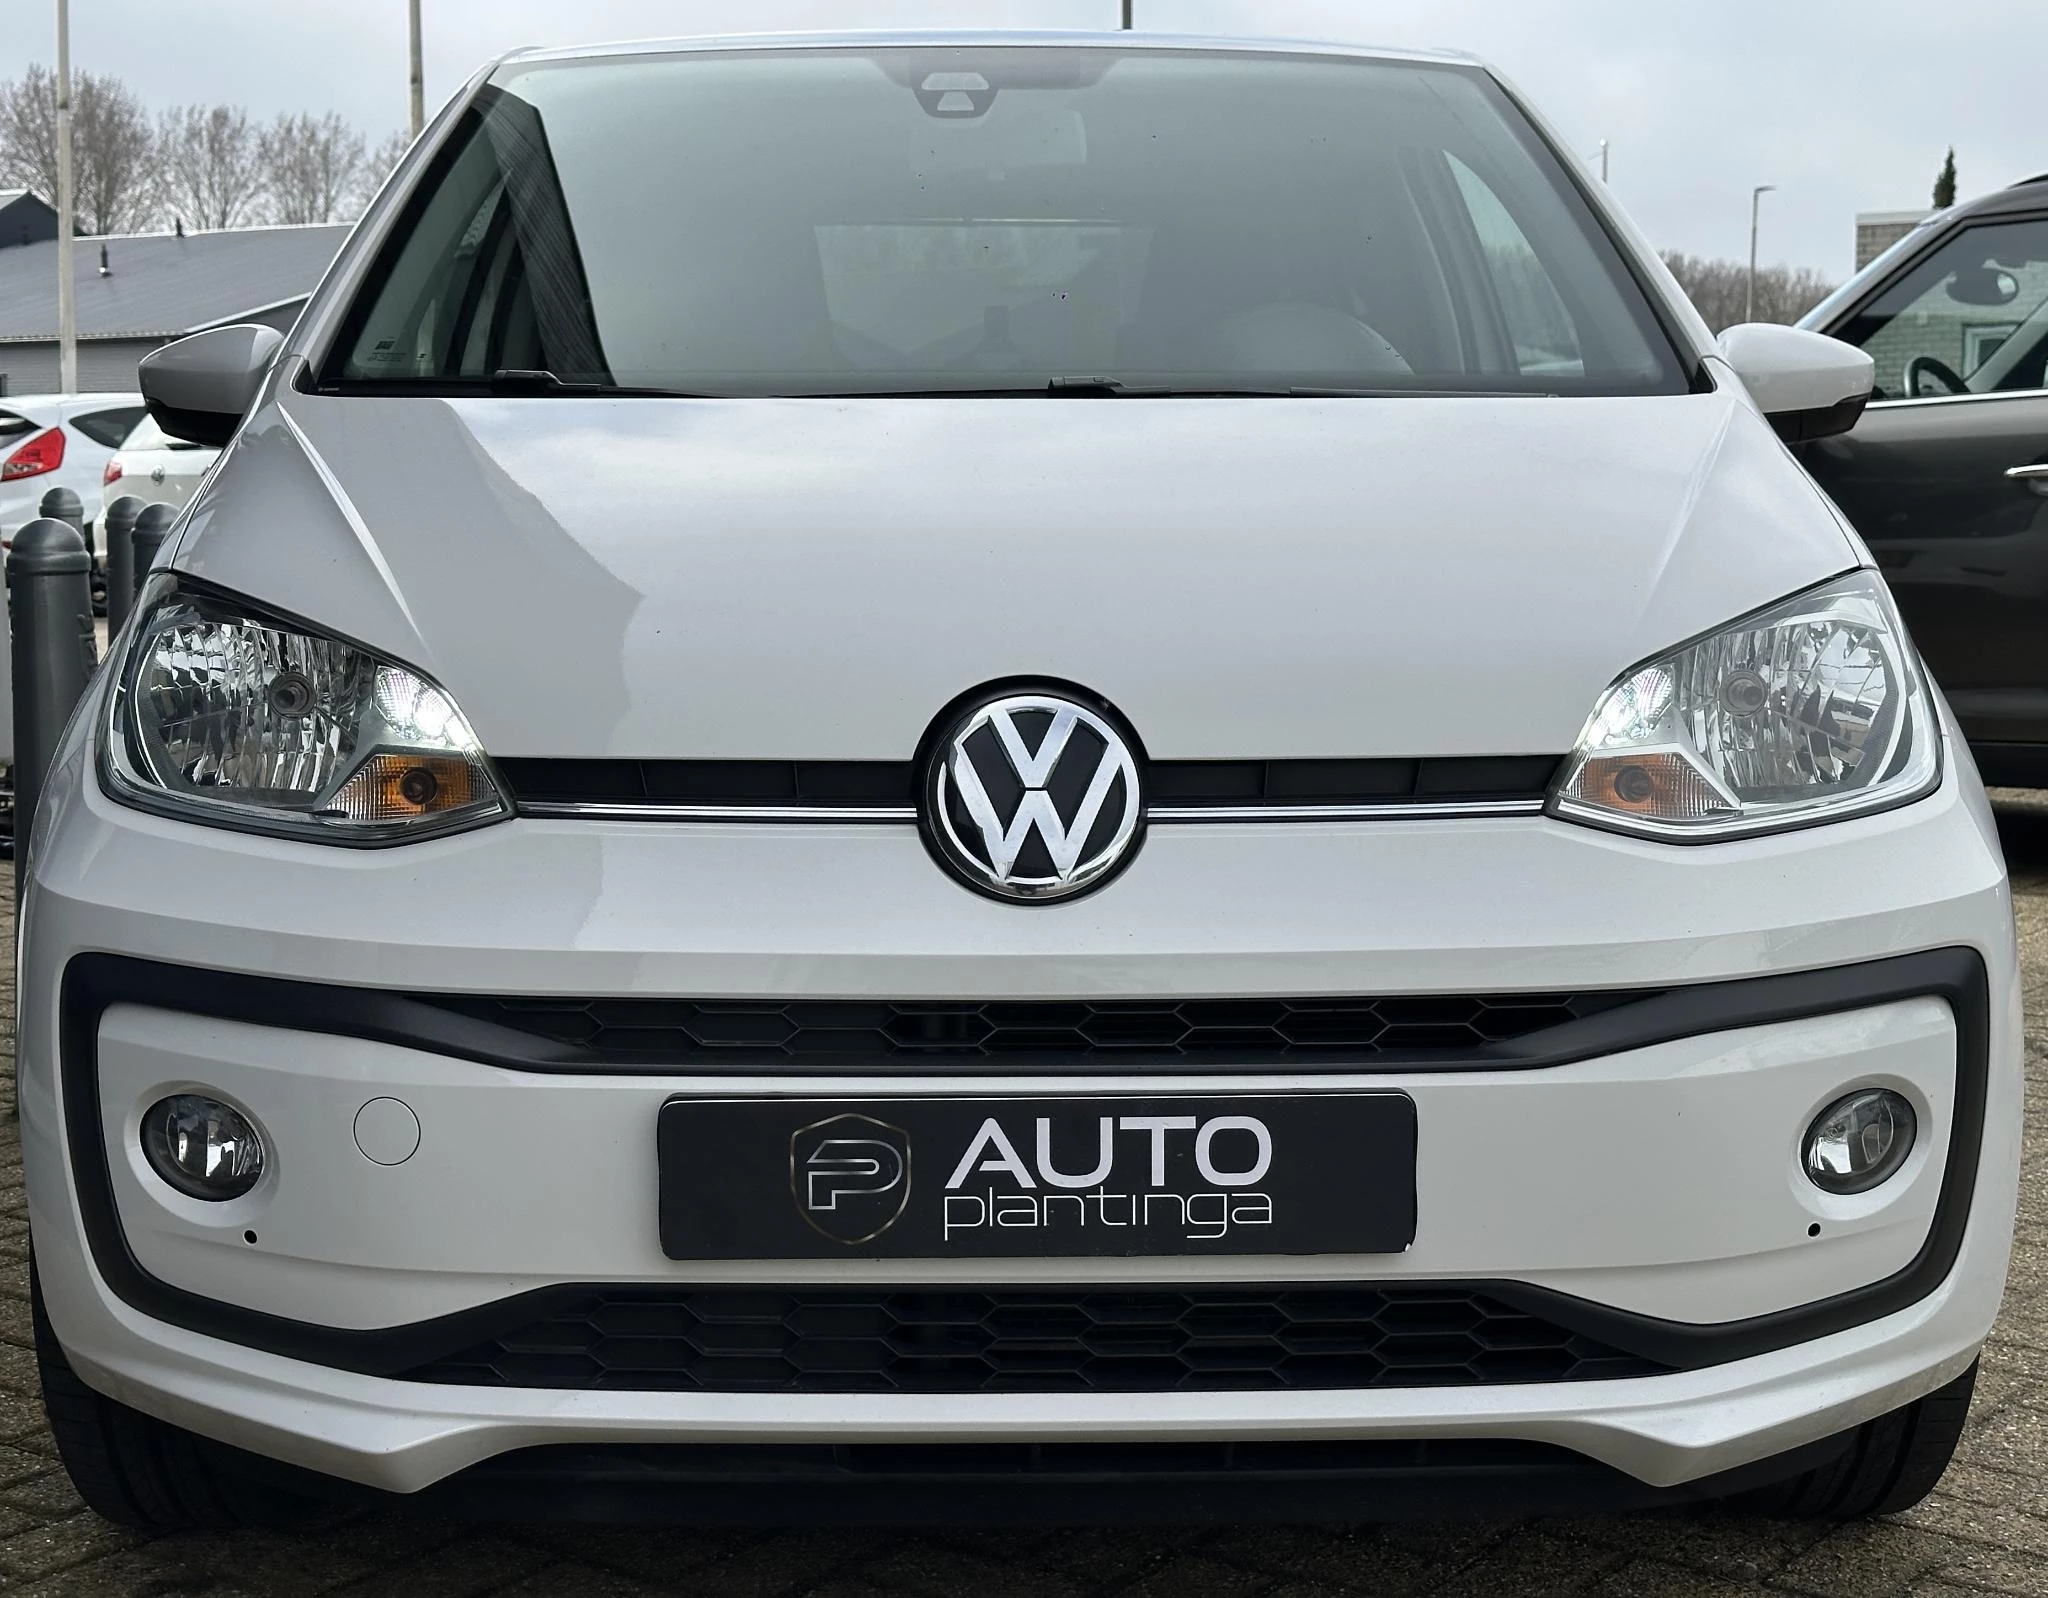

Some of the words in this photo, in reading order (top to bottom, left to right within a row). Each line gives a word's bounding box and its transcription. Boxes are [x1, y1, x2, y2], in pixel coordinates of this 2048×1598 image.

[949, 701, 1124, 887] VW
[807, 1139, 902, 1210] P
[944, 1116, 1273, 1187] AUTO
[944, 1187, 1273, 1241] plantinga
